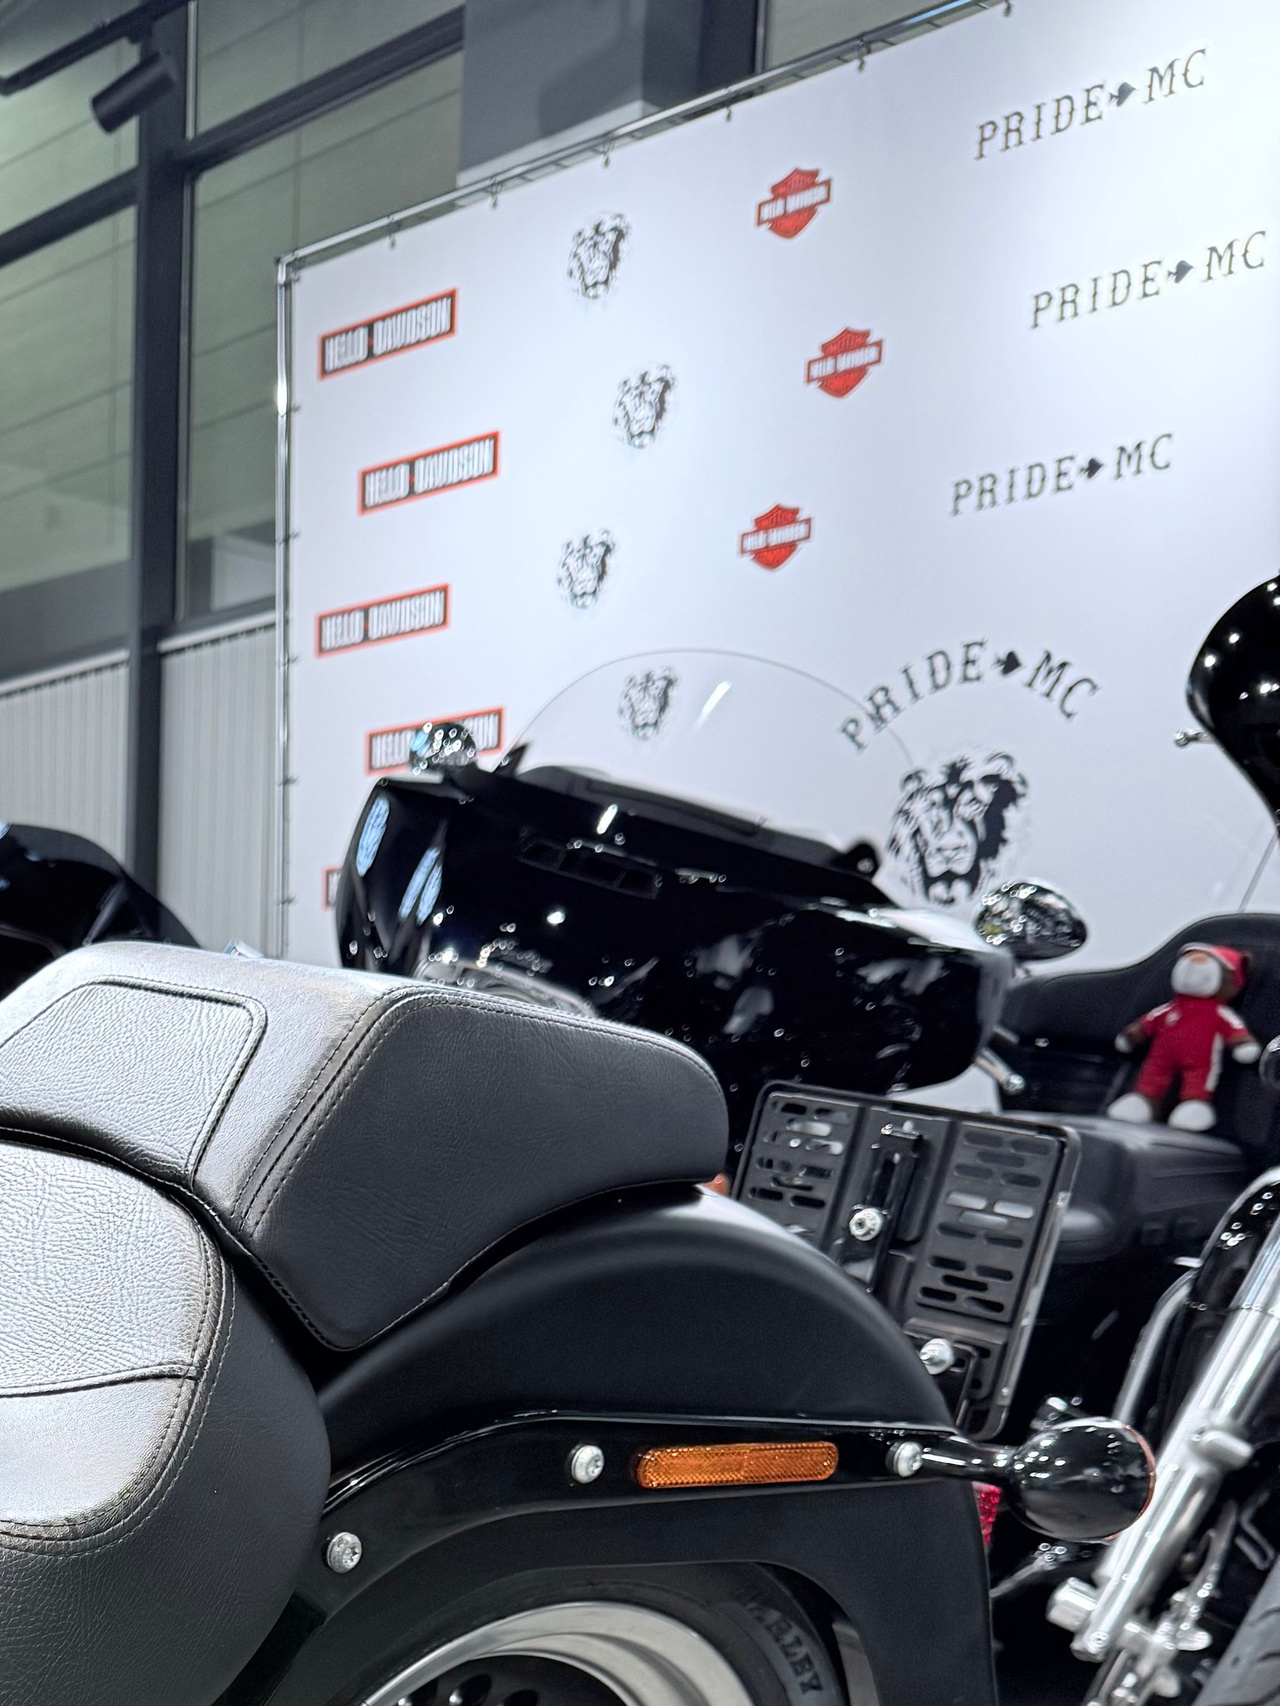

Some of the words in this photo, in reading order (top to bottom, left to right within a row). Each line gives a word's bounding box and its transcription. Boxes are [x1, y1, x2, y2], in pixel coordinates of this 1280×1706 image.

[974, 83, 1104, 160] PRIDE
[1143, 48, 1206, 104] MC
[1030, 260, 1162, 329] PRIDE
[1203, 230, 1266, 282] MC
[951, 456, 1075, 516] PRIDE
[1113, 433, 1173, 480] MC
[841, 639, 987, 752] PRIDE
[1025, 650, 1100, 720] MC
